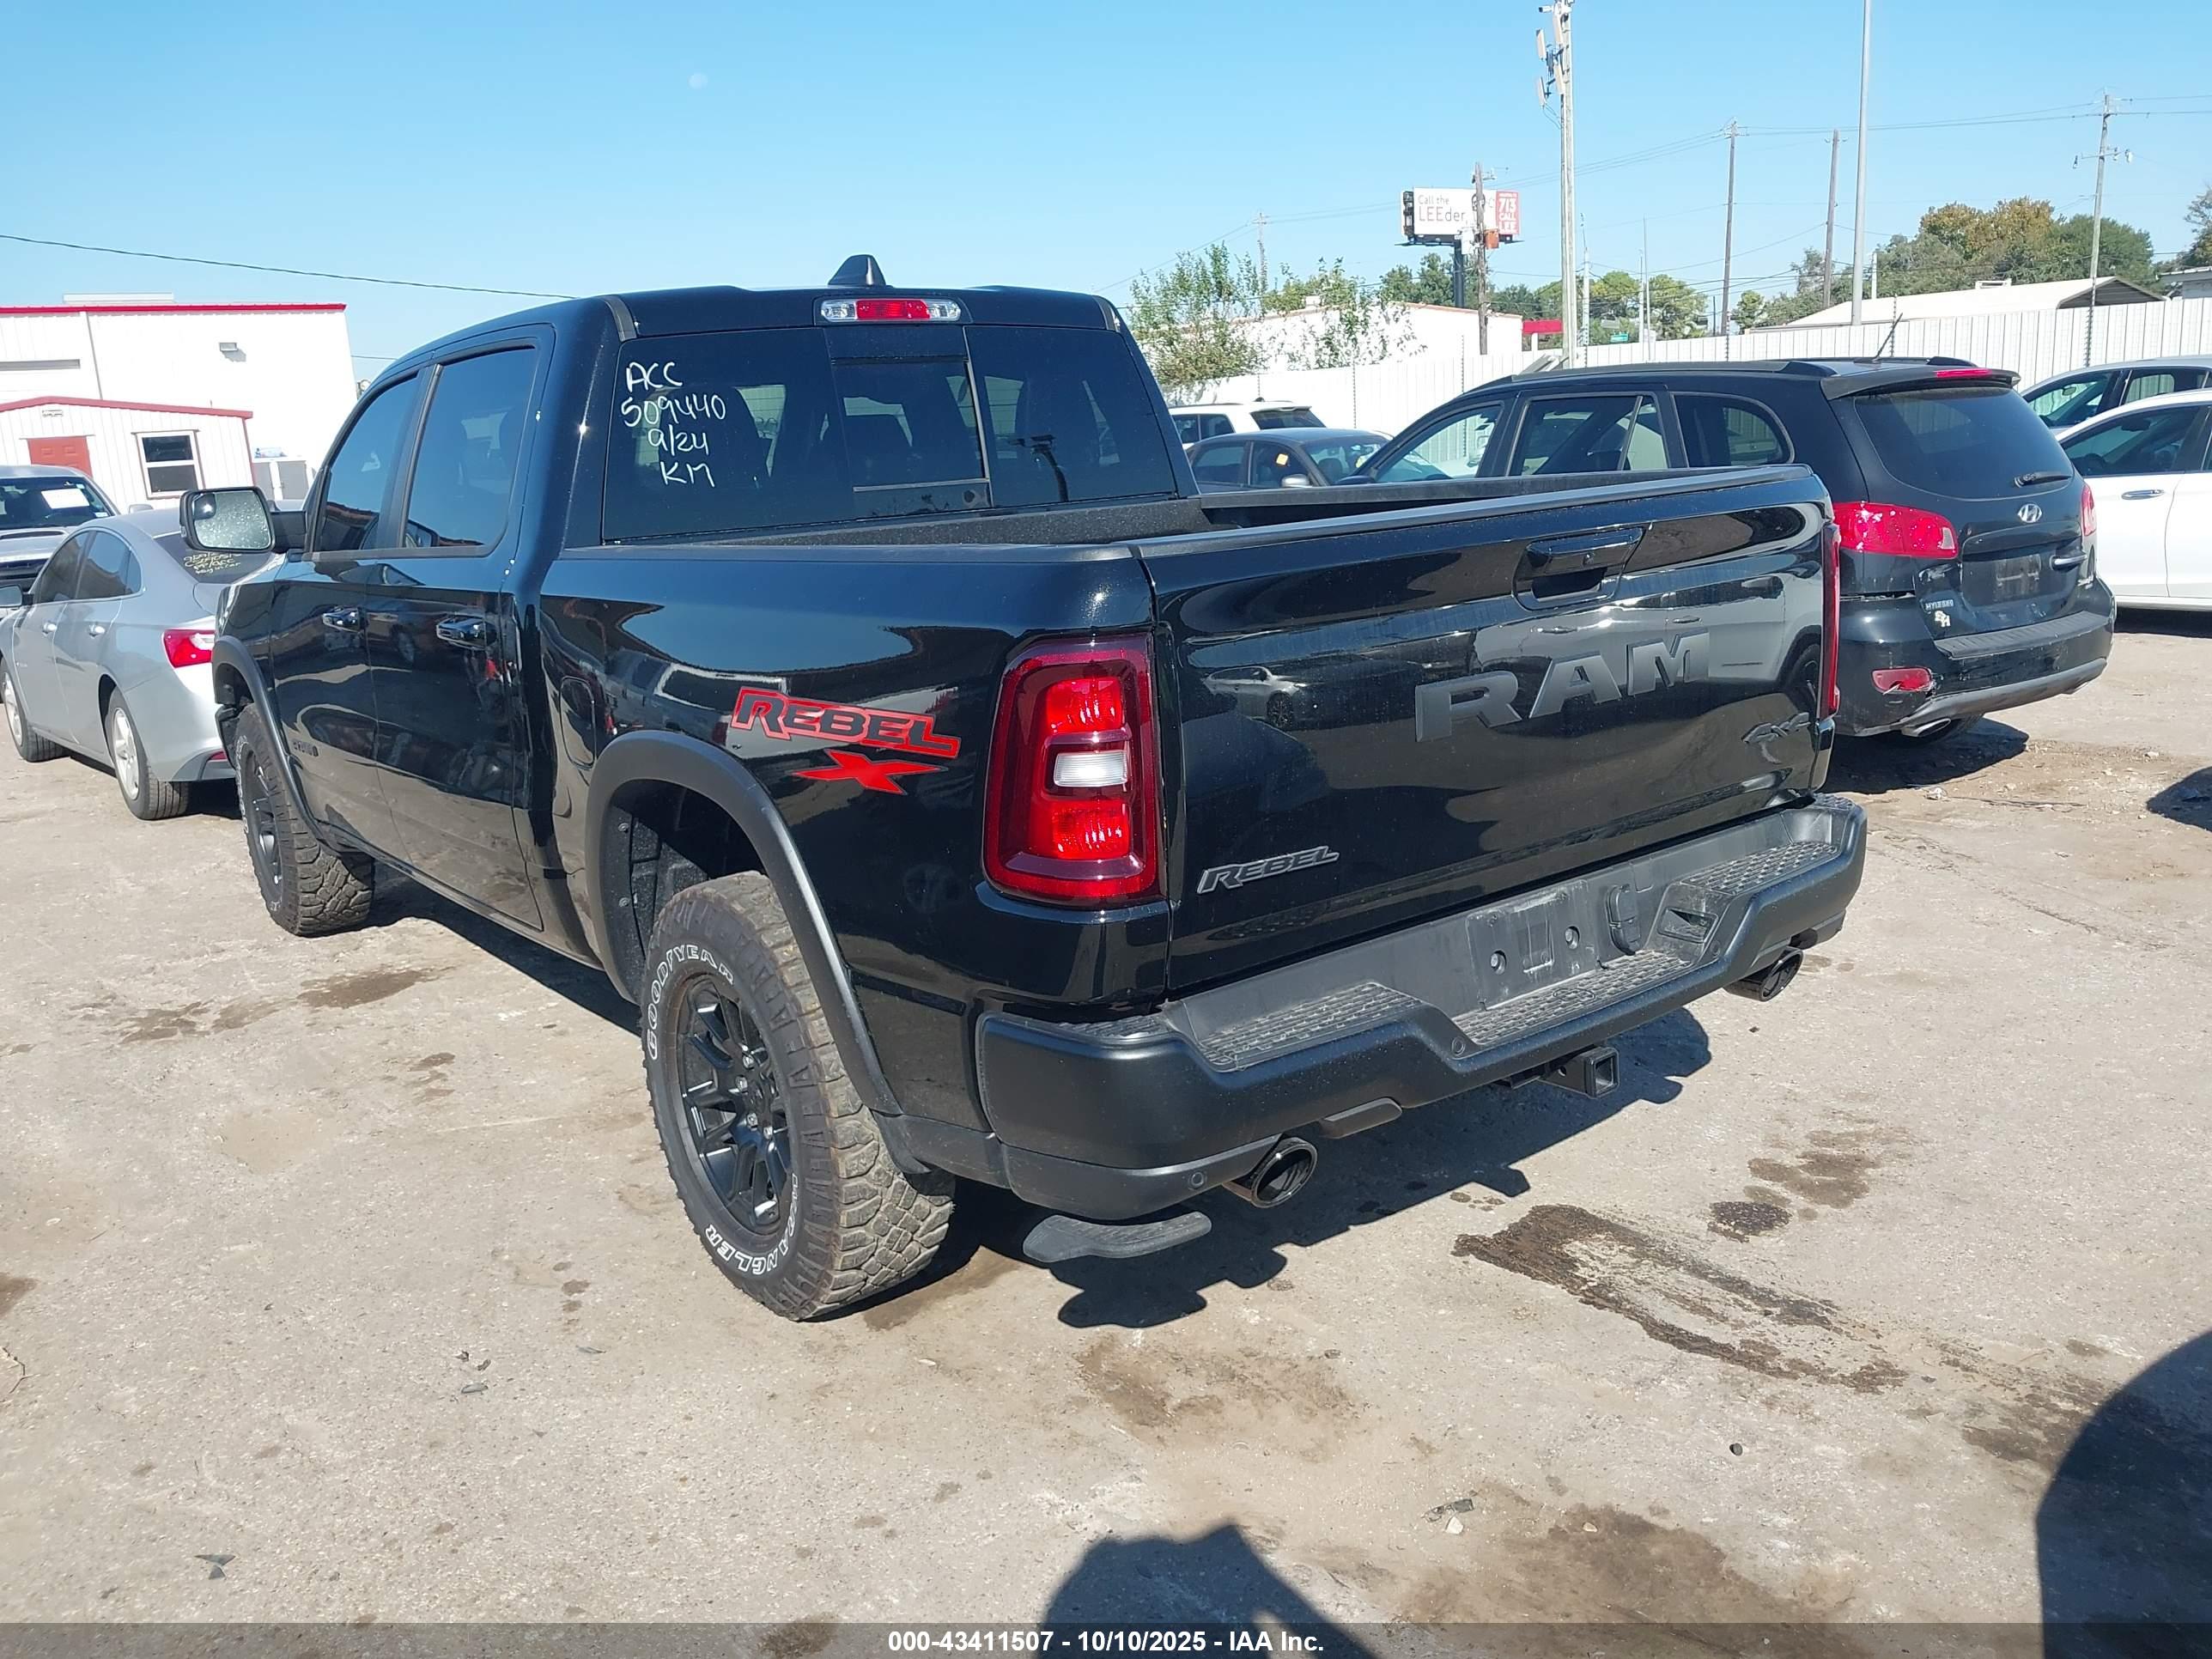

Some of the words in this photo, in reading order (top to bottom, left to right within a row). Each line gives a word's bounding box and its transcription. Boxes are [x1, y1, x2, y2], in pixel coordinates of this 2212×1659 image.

[1417, 194, 1434, 205] Call
[1437, 195, 1449, 205] the
[1498, 198, 1517, 213] 713
[1498, 221, 1518, 234] LEE
[626, 362, 683, 392] ACC
[621, 393, 726, 427] 509440
[647, 424, 709, 456] 9/24
[1415, 629, 1710, 742] RAM
[731, 686, 962, 759] REBEL
[1196, 845, 1340, 895] REBEL
[647, 944, 735, 1060] GOODYEAR
